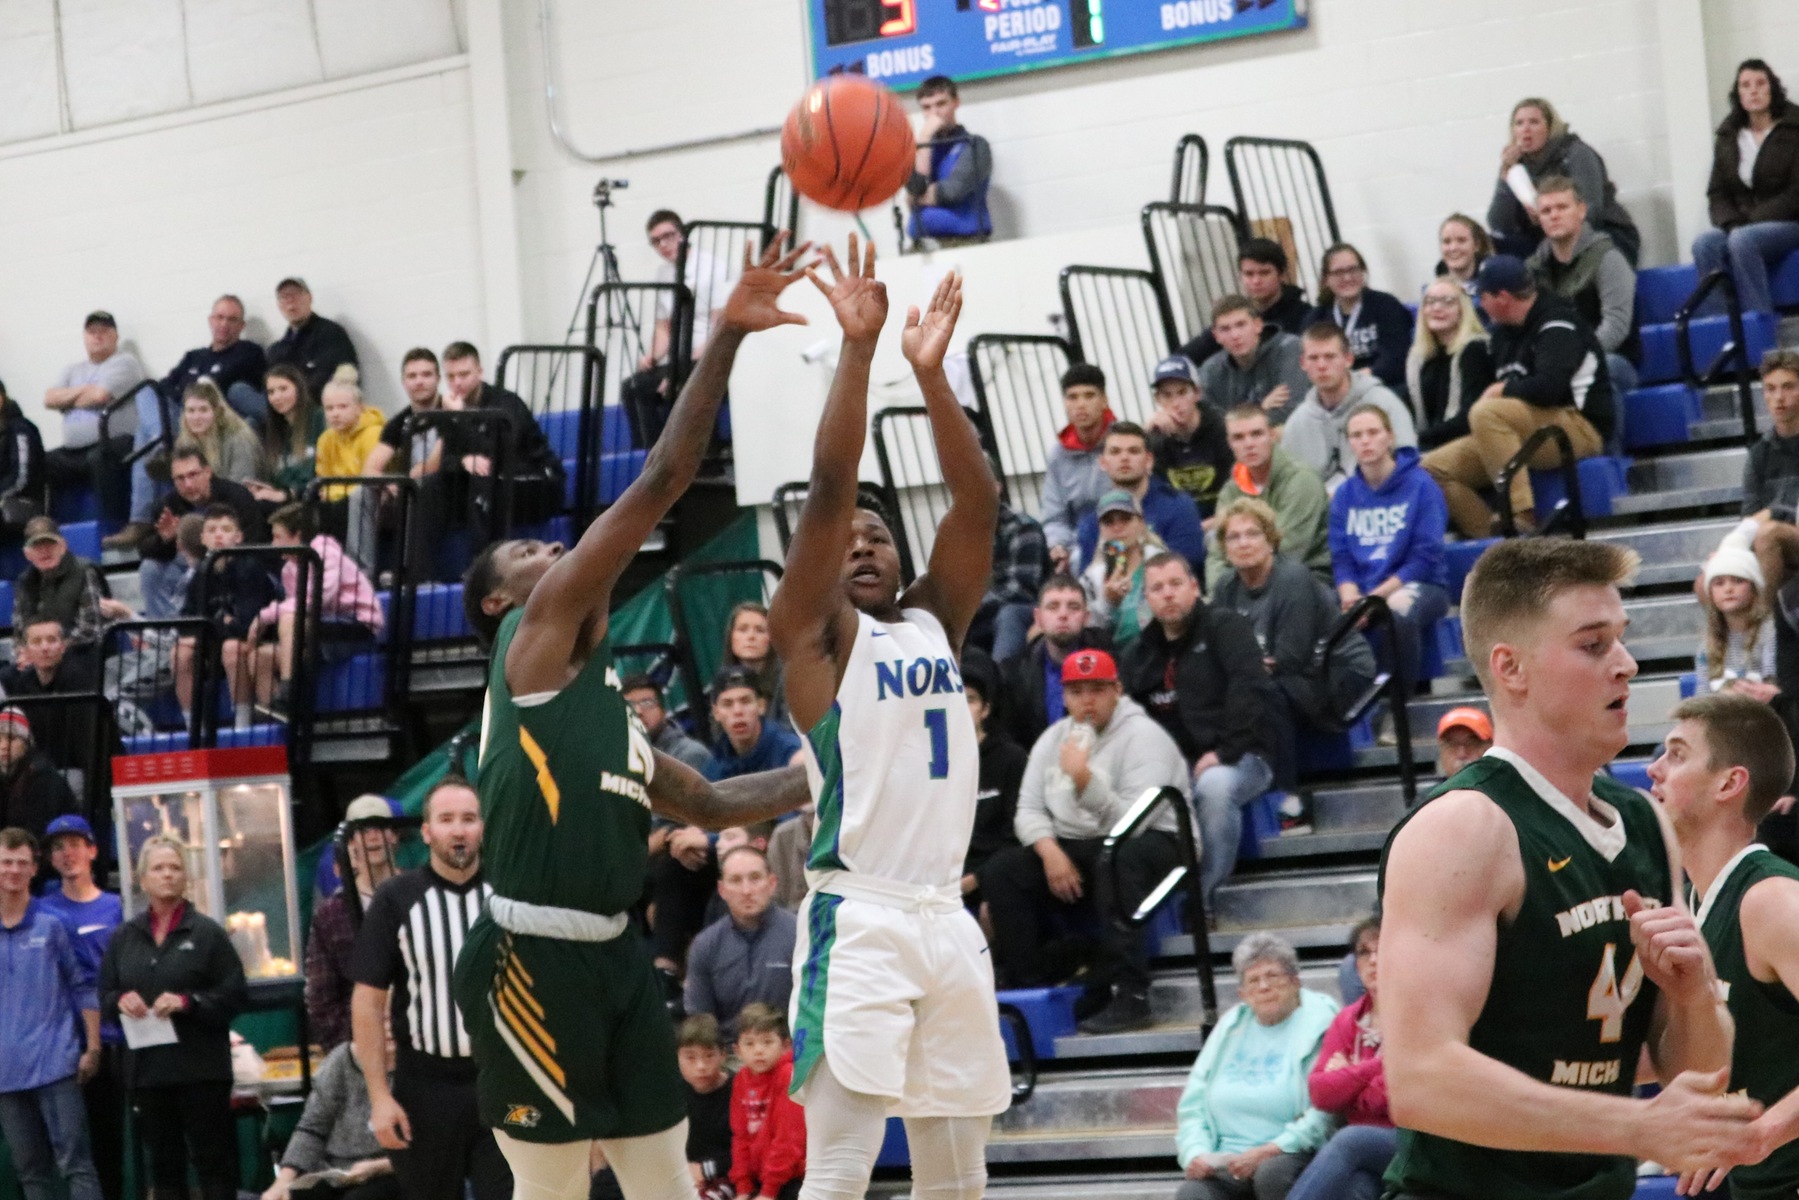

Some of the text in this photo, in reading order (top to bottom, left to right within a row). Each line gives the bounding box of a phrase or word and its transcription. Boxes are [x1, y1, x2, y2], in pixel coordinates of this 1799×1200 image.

[984, 4, 1061, 41] PERIOD
[1160, 0, 1235, 31] BONUS
[866, 43, 935, 79] BONUS
[924, 708, 949, 780] 1
